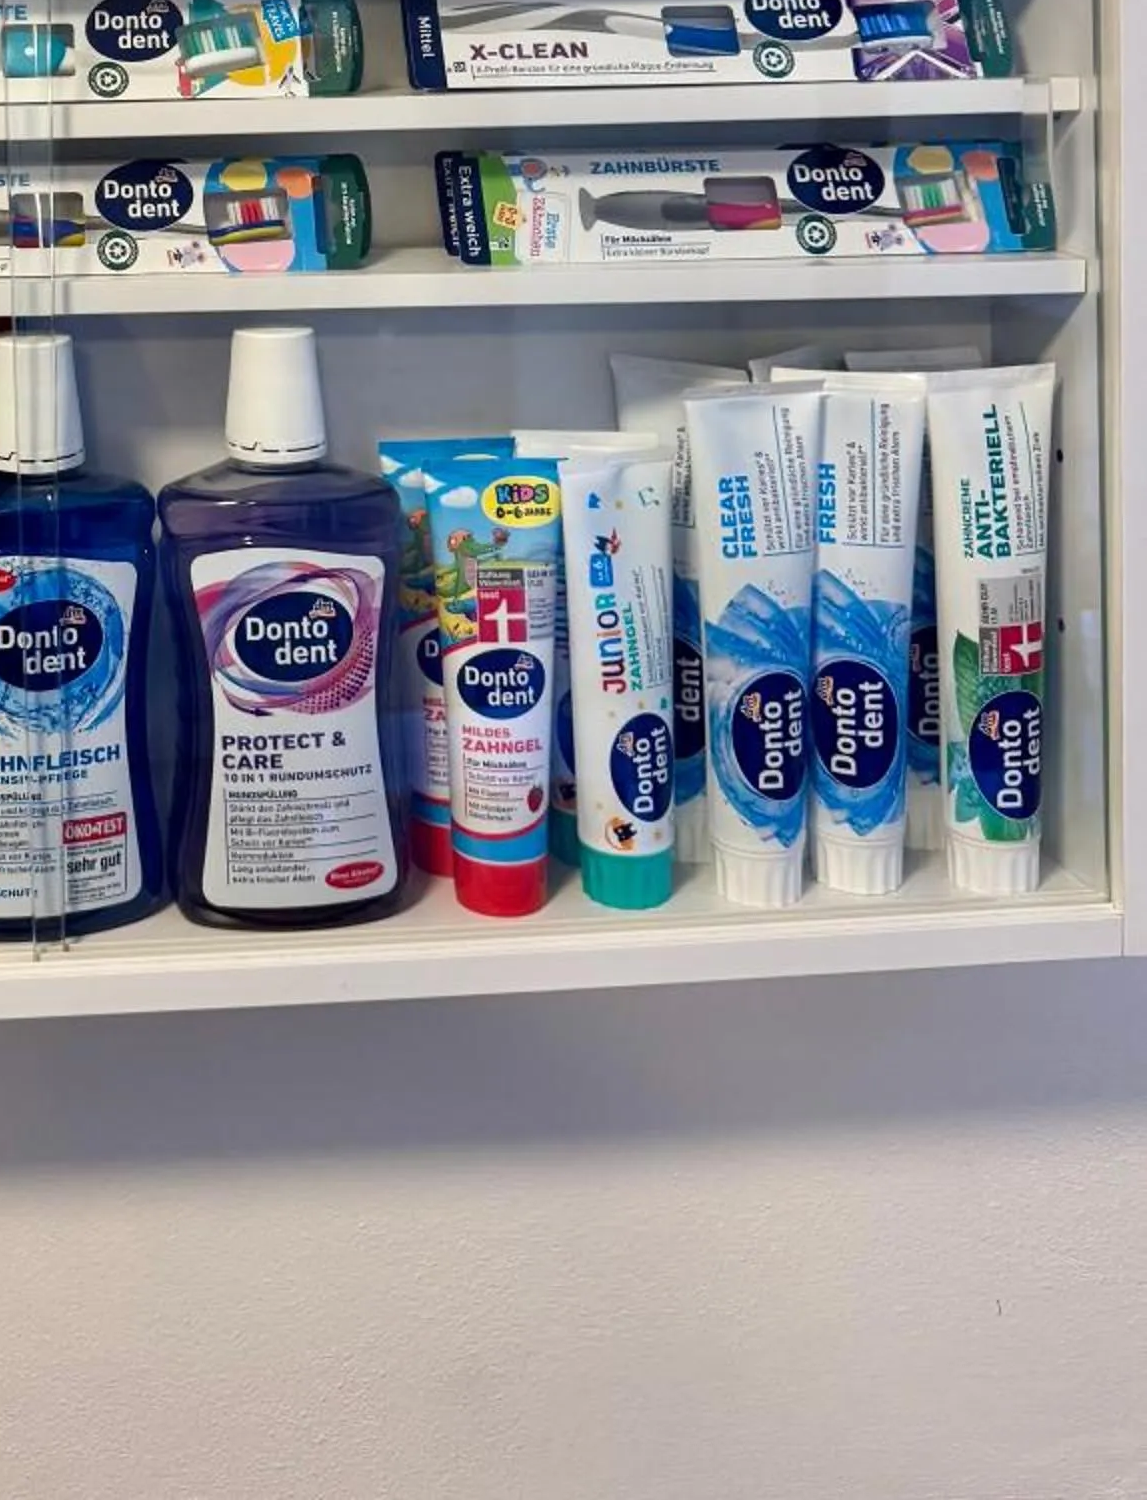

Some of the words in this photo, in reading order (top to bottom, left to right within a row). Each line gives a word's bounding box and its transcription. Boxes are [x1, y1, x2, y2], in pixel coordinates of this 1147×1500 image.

[94, 11, 163, 30] Donto
[778, 11, 831, 29] dent
[118, 30, 170, 49] dent
[418, 15, 435, 59] Mittel
[469, 42, 588, 60] X-CLEAN
[590, 159, 720, 175] ZAHNBÜRSTE
[794, 164, 863, 183] Donto
[104, 180, 172, 199] Donto
[822, 182, 874, 201] dent
[128, 200, 180, 217] dent
[458, 165, 471, 207] Extra
[465, 211, 482, 257] weich
[983, 404, 1012, 558] BAKTERIELL
[718, 476, 740, 559] CLEAR
[736, 475, 758, 558] FRESH
[818, 462, 836, 545] FRESH
[961, 479, 974, 559] ZAHNCREME
[974, 489, 993, 560] ANTI-
[246, 617, 328, 641] Donto
[275, 641, 338, 665] dent
[624, 601, 644, 692] ZAHNGEL
[25, 647, 86, 675] dent
[464, 666, 530, 686] Donto
[677, 656, 701, 723] dent
[487, 690, 536, 707] dent
[784, 688, 803, 757] dent
[859, 681, 884, 749] dent
[222, 733, 325, 751] PROTECT
[332, 731, 346, 747] &
[462, 738, 543, 753] ZAHNGEL
[759, 700, 785, 791] Donto
[830, 687, 858, 777] Donto
[1023, 705, 1041, 775] dent
[223, 754, 284, 770] CARE
[653, 725, 668, 784] dent
[997, 720, 1023, 809] Donto
[224, 774, 238, 783] 10
[242, 774, 254, 783] IN
[258, 773, 264, 783] 1
[270, 764, 372, 782] RUNDUMSCHUTZ
[632, 737, 653, 814] Donto
[67, 856, 95, 874] sehr
[100, 851, 121, 873] gut
